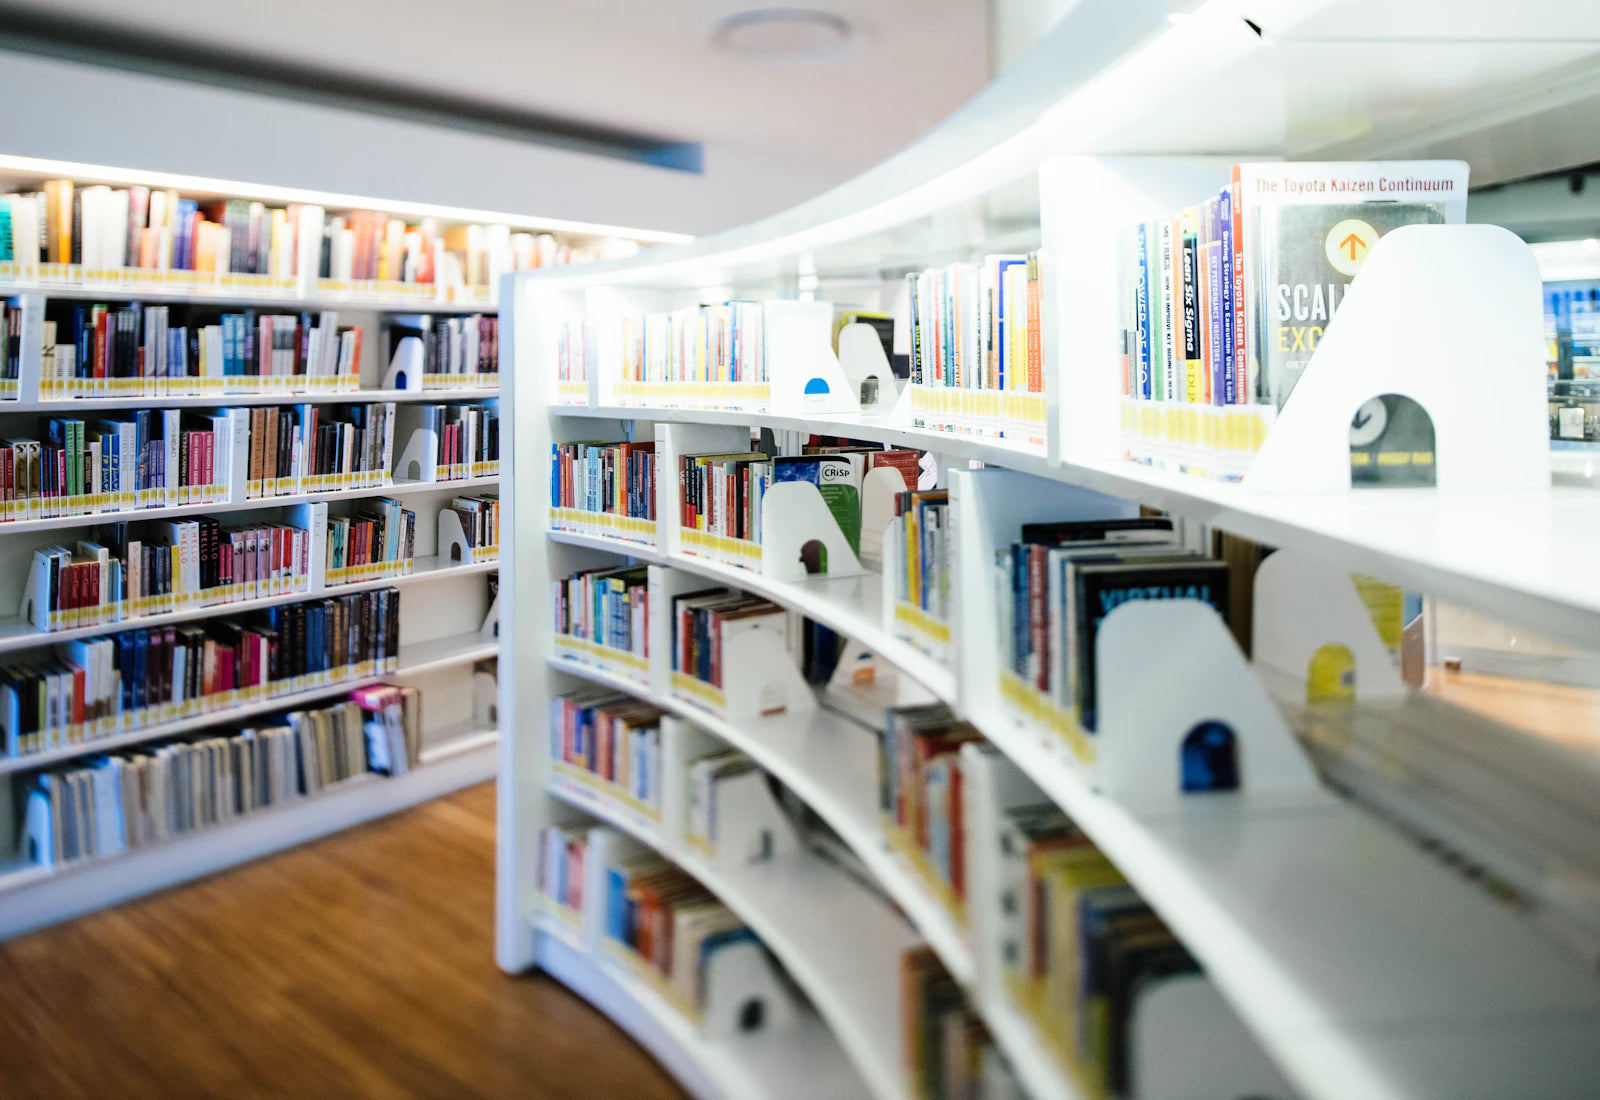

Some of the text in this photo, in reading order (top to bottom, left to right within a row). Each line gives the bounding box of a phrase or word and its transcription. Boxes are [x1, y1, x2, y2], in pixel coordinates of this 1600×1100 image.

[1256, 177, 1454, 195] The Toyota Kaizen Continuum
[1235, 251, 1243, 271] The
[1211, 271, 1219, 320] PERFORMANCE
[1222, 263, 1231, 300] Strategy
[1234, 273, 1244, 308] Toyota
[1183, 247, 1196, 352] Lean Six Sigma
[1224, 302, 1231, 311] to
[1212, 322, 1220, 362] INDICATORS
[1236, 311, 1245, 345] Kaizen
